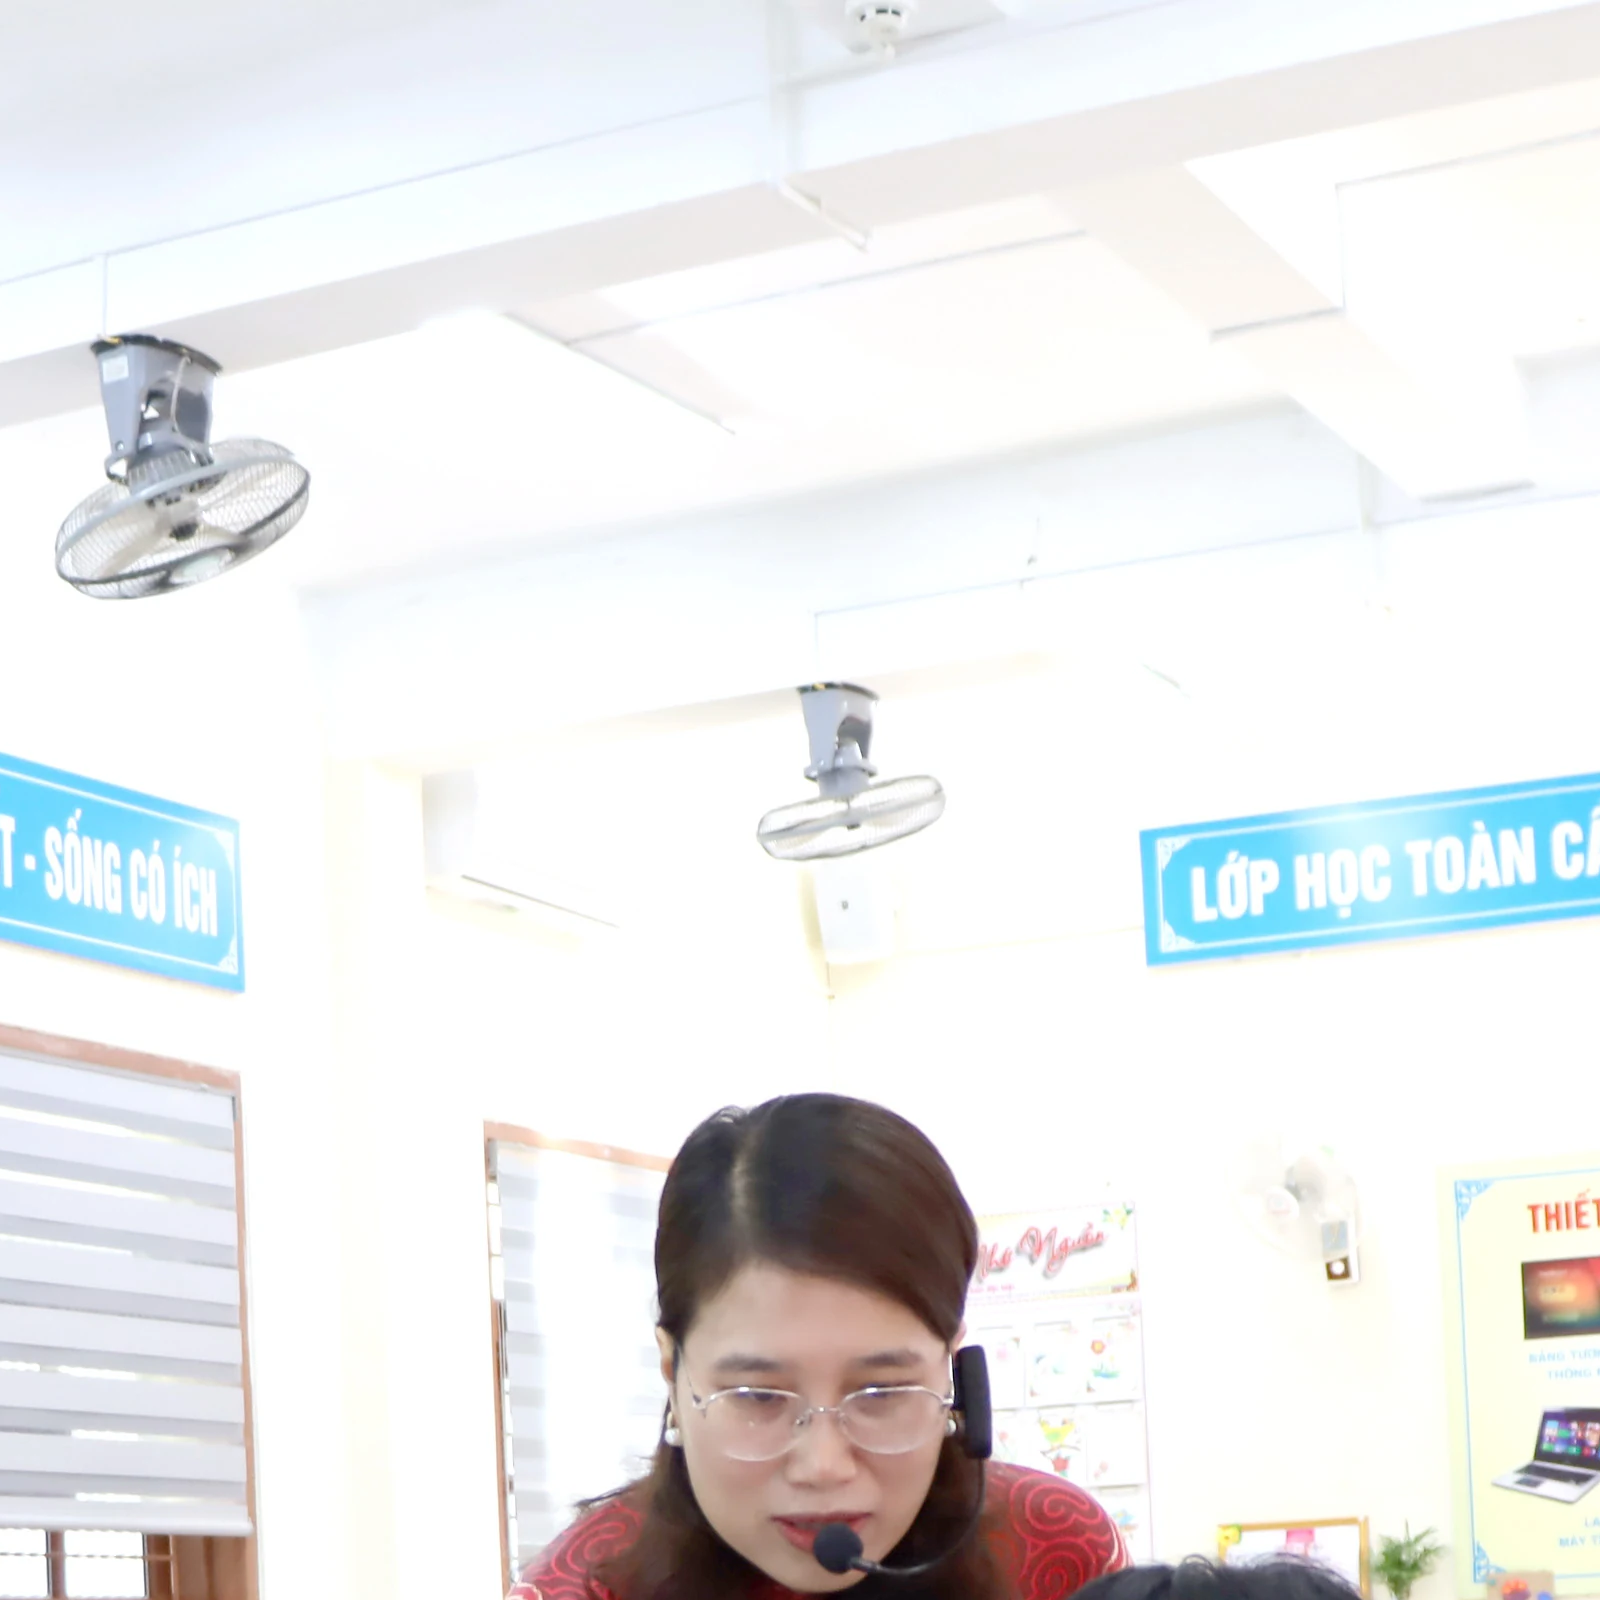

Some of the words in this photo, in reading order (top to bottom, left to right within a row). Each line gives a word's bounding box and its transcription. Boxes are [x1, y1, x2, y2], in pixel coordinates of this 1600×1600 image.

[24, 854, 36, 871] -
[44, 808, 123, 915] SỐNG
[129, 839, 167, 925] CÓ
[173, 846, 218, 937] ÍCH
[1190, 848, 1281, 922] LỚP
[1293, 848, 1392, 914] HỌC
[1407, 824, 1537, 895] TOÀN
